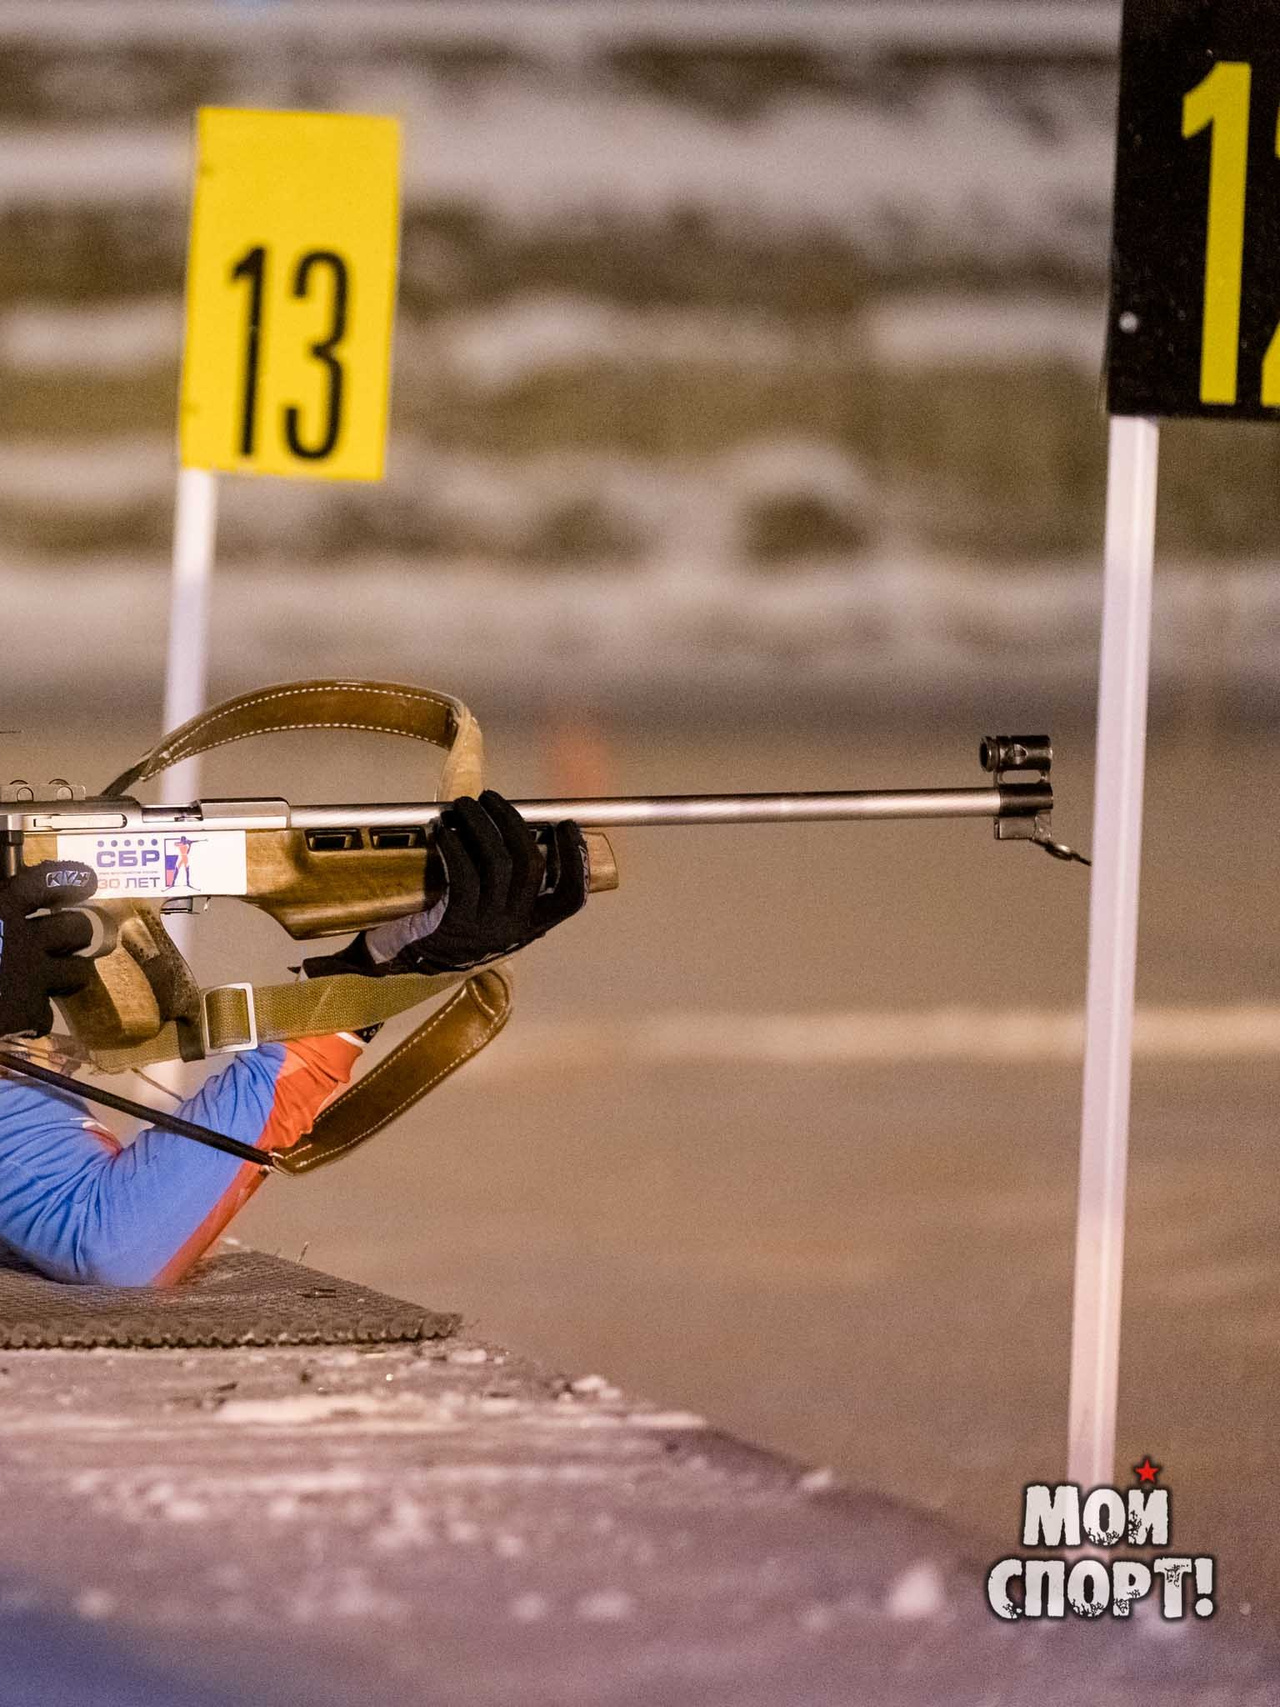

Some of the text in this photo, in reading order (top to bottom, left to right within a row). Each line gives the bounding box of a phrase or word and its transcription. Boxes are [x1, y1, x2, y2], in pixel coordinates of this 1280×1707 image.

[1181, 61, 1280, 408] 1
[231, 246, 348, 460] 13
[96, 850, 160, 867] СБР
[97, 877, 161, 889] 30 ЛЕТ
